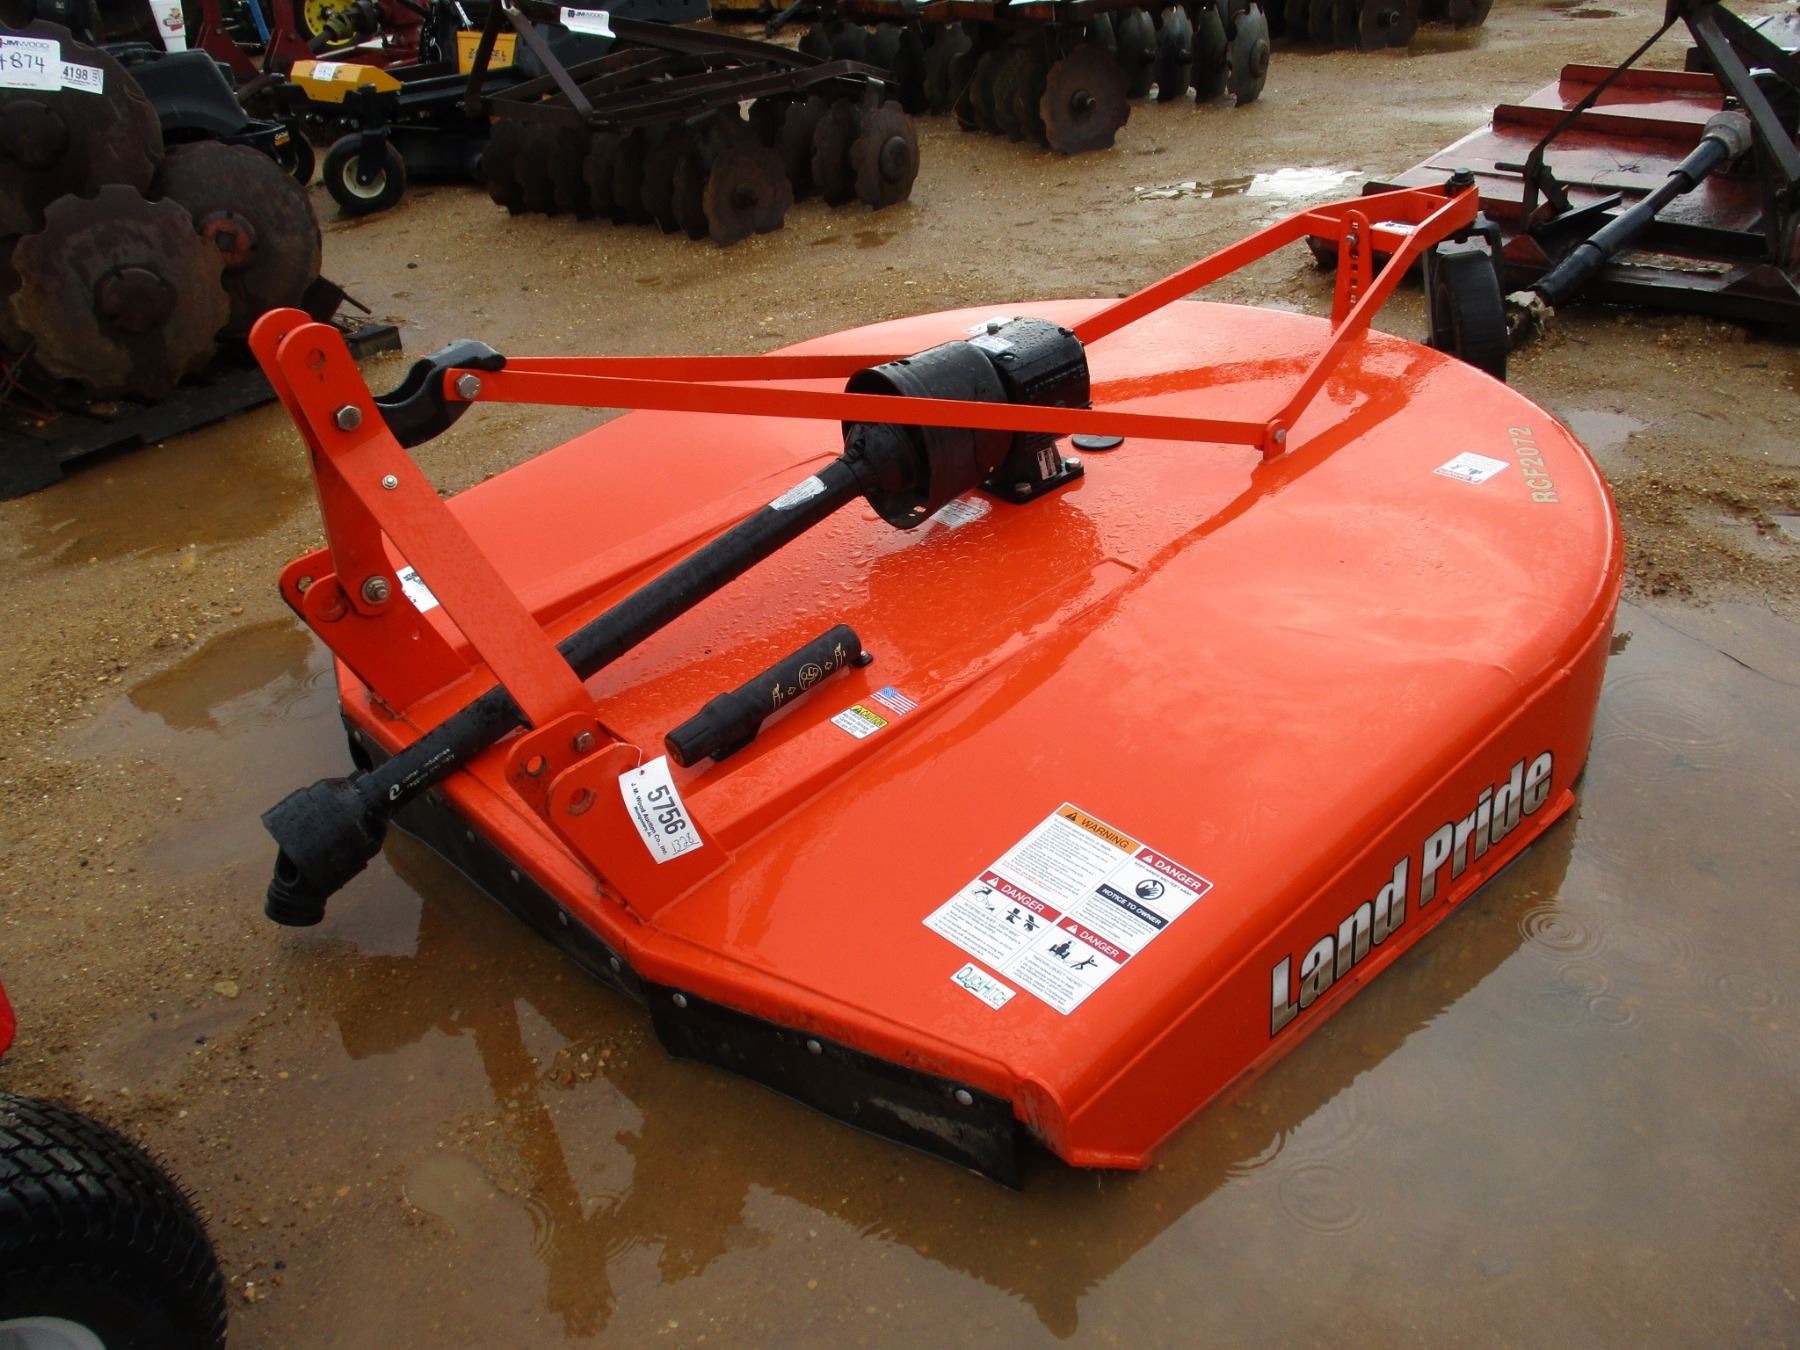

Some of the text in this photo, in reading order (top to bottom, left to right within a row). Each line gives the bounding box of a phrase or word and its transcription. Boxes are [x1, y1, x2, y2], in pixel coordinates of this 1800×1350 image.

[62, 65, 88, 81] 4198
[1507, 426, 1560, 503] RCF2072
[636, 795, 647, 813] Wood
[643, 813, 657, 834] Auction
[647, 784, 686, 835] 5756
[1081, 817, 1130, 849] WARNING
[1155, 860, 1202, 890] DANGER
[1001, 884, 1045, 913] DANGER
[1101, 888, 1162, 926] NOTICE TO OWNER
[1270, 855, 1409, 1040] Land
[1419, 749, 1553, 909] Pride
[1080, 930, 1120, 958] DANGER
